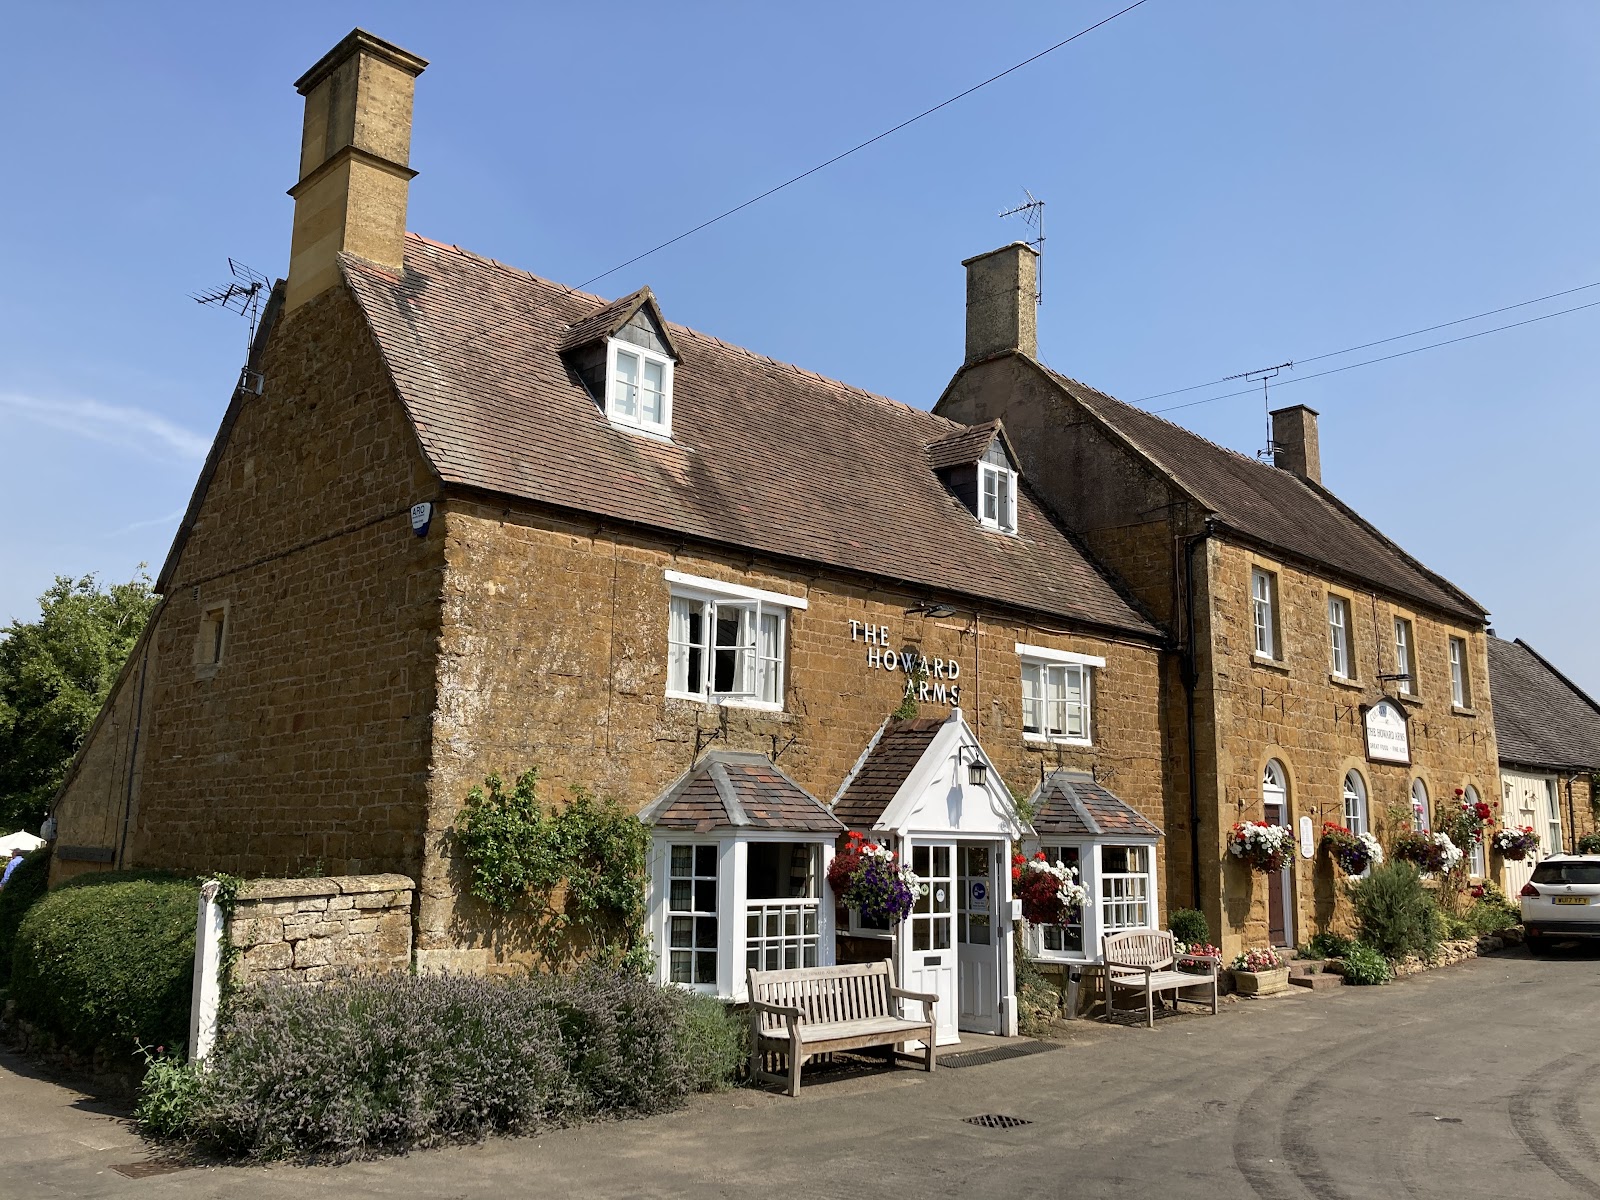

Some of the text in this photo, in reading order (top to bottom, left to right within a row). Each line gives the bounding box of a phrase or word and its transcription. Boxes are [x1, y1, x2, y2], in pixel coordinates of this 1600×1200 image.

[848, 618, 890, 647] THE
[867, 646, 960, 680] HOWARD
[903, 678, 960, 705] ARMS
